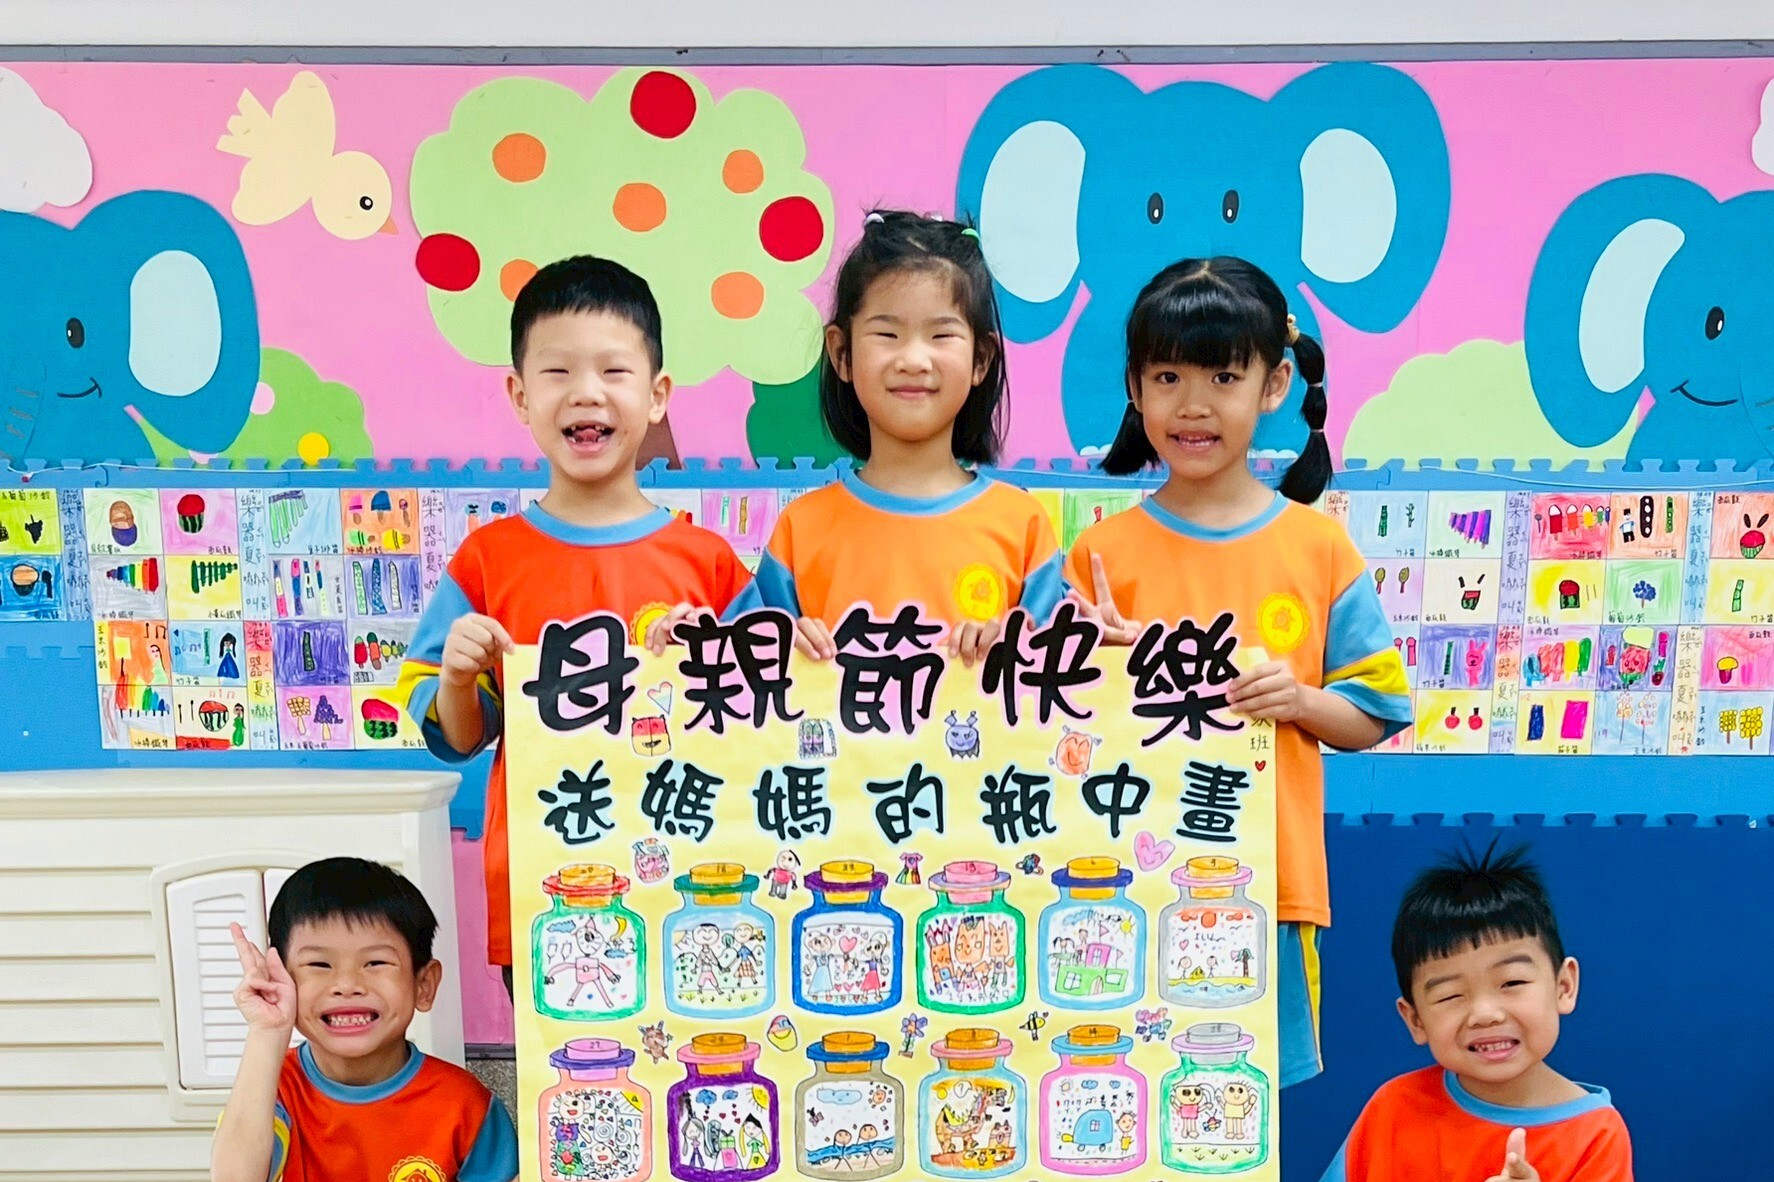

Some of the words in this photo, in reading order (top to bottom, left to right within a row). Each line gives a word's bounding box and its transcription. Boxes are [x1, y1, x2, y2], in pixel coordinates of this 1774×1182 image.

[522, 603, 1245, 747] 母親節快樂
[1250, 717, 1272, 751] 班
[538, 760, 1249, 844] 送媽媽的瓶中畫
